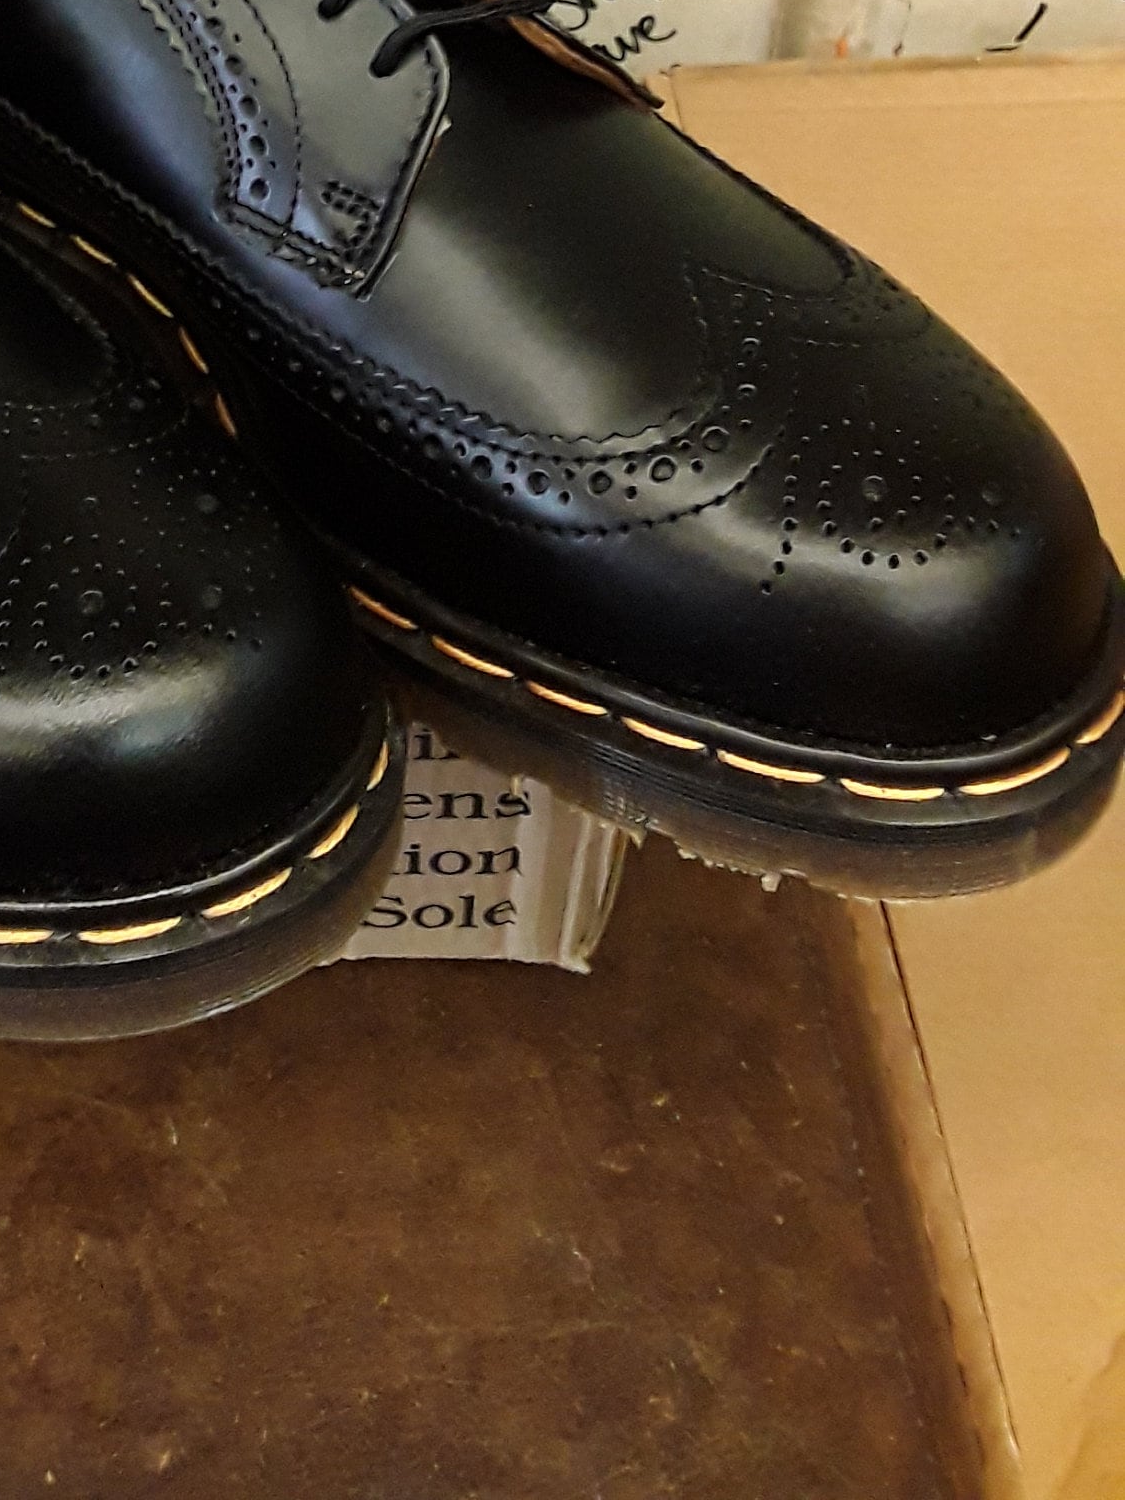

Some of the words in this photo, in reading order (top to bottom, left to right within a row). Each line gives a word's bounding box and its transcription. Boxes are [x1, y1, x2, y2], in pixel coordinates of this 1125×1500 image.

[403, 790, 532, 820] ens
[402, 843, 523, 877] ion
[360, 895, 517, 929] Sole
